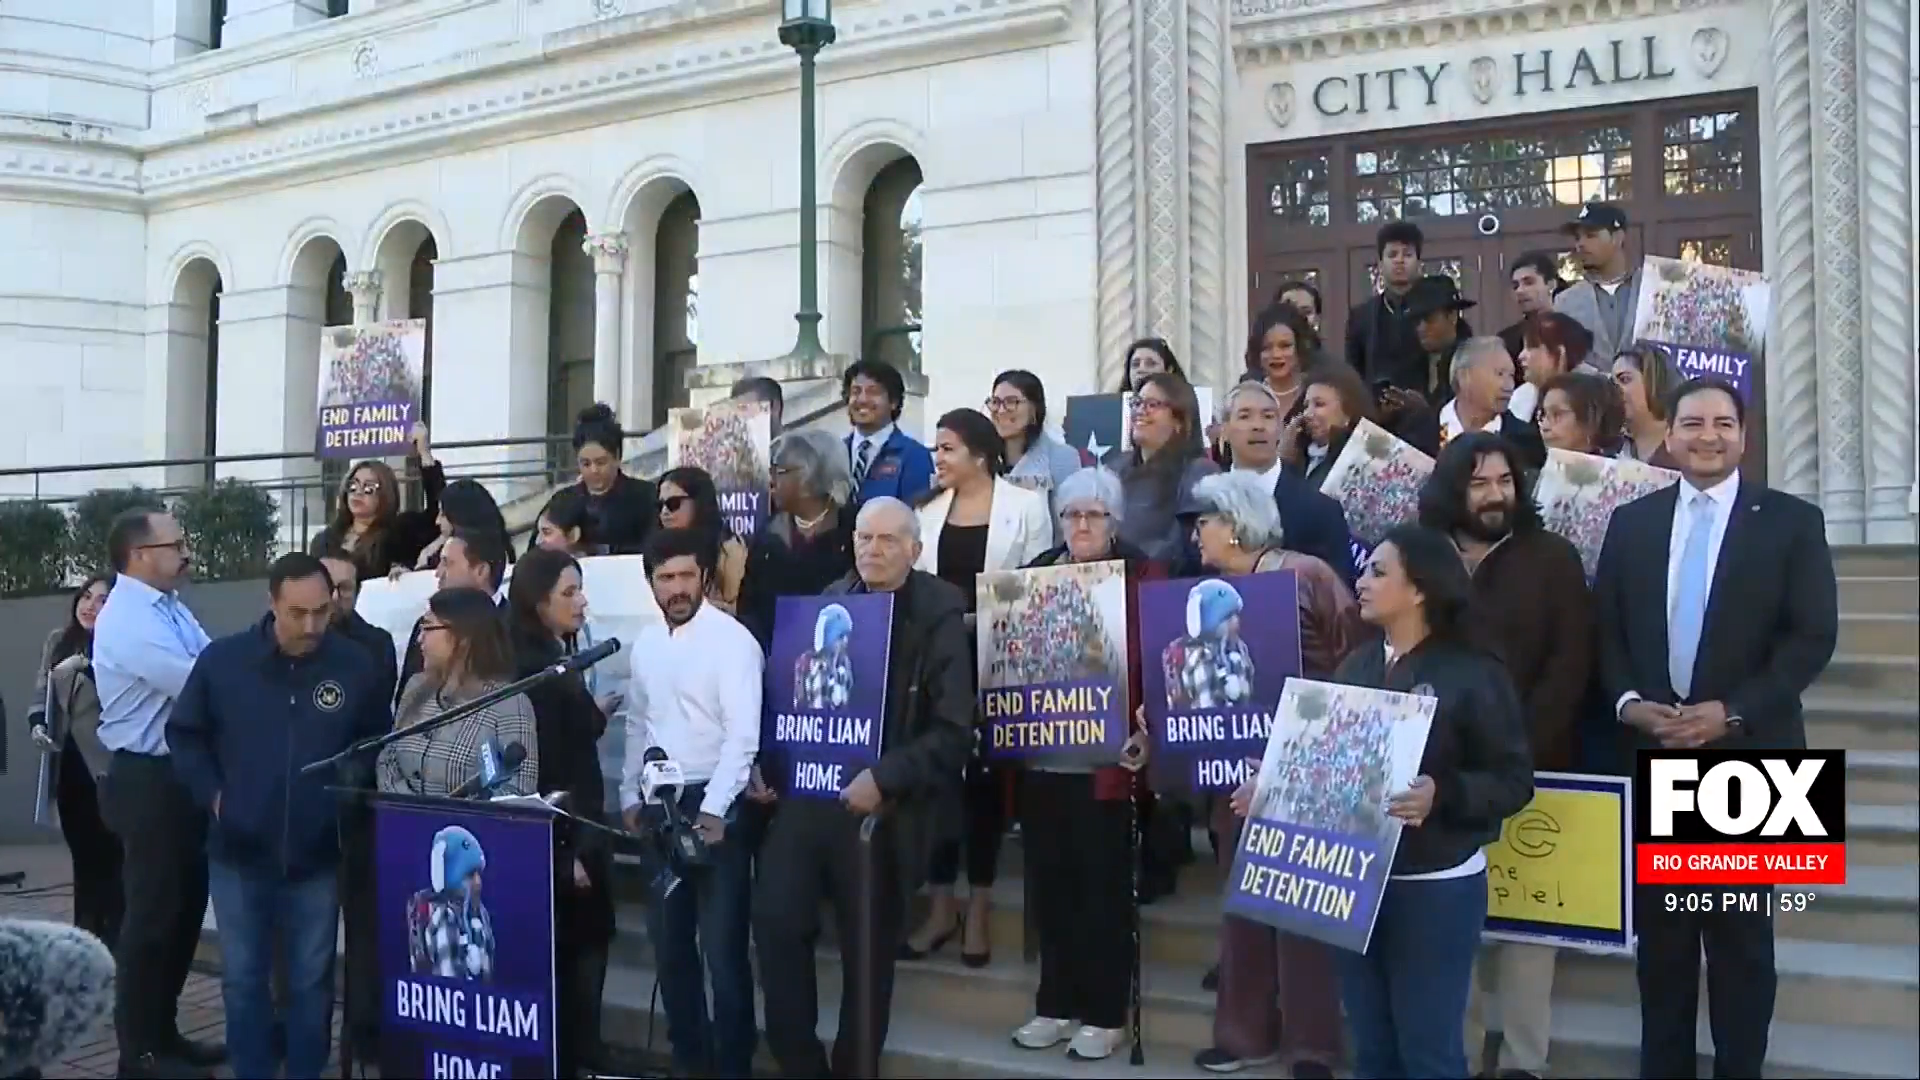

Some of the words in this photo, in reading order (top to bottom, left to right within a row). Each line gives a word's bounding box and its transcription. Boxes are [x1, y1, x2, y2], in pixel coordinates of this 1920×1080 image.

[1313, 62, 1449, 116] CITY
[1513, 36, 1675, 96] HALL
[1677, 348, 1748, 377] FAMILY
[322, 408, 350, 426] END
[353, 403, 411, 425] FAMILY
[325, 425, 405, 448] DETENTION
[715, 491, 760, 512] MILY
[986, 691, 1024, 717] END
[1031, 686, 1112, 715] FAMILY
[776, 714, 823, 743] BRING
[828, 717, 872, 746] LIAM
[993, 719, 1106, 748] DETENTION
[1166, 716, 1225, 742] BRING
[795, 761, 843, 792] HOME
[1245, 823, 1286, 858] END
[1287, 833, 1376, 882] FAMILY
[1240, 861, 1356, 922] DETENTION
[397, 979, 466, 1028] BRING
[475, 992, 539, 1041] LIAM
